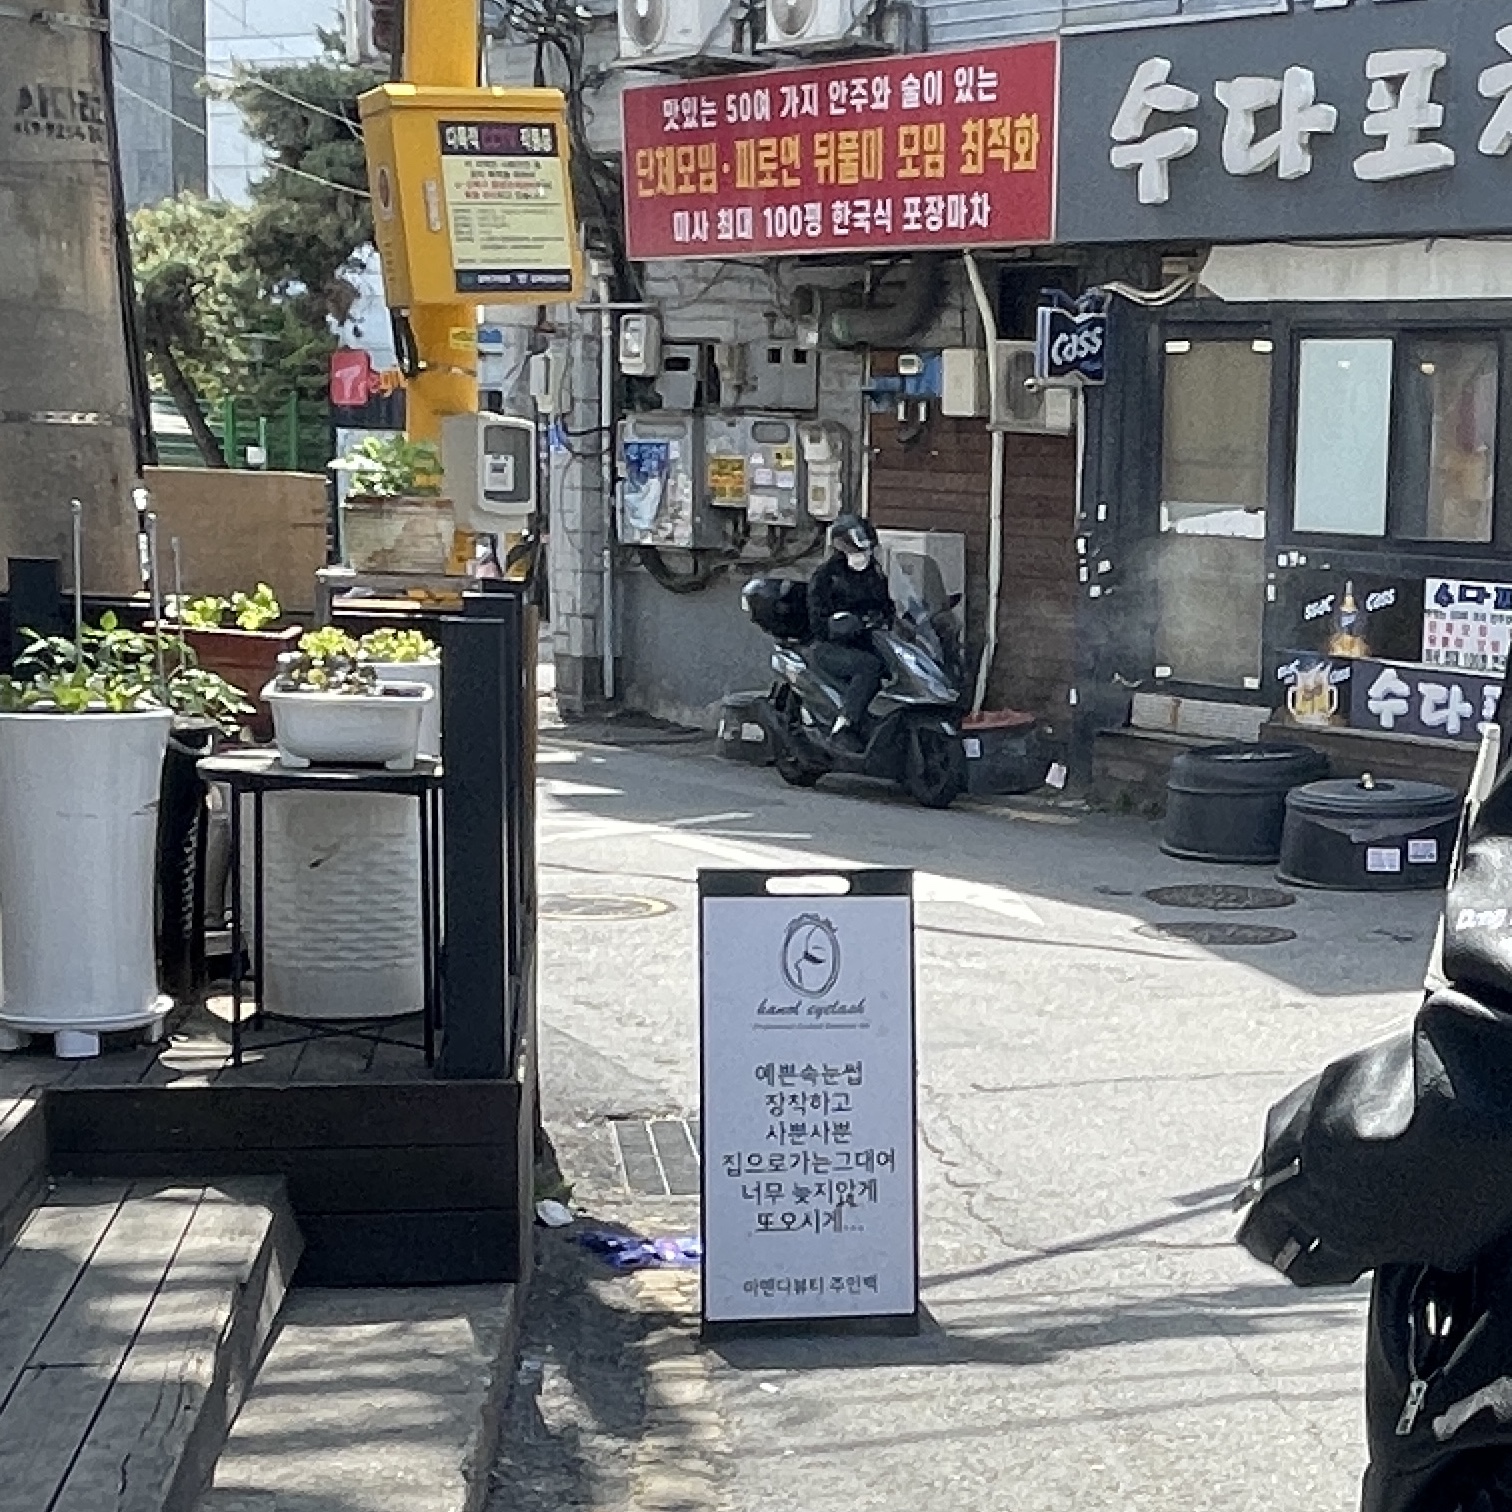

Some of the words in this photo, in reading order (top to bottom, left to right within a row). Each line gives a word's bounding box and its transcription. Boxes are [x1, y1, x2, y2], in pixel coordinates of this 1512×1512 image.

[663, 96, 717, 132] 맛있는
[725, 88, 771, 124] 50여
[779, 82, 819, 119] 가지
[828, 75, 892, 116] 안주와
[900, 69, 944, 110] 술이
[953, 65, 999, 104] 있는
[813, 126, 885, 185] 뒤풀이
[896, 122, 946, 180] 모임
[959, 112, 1041, 175] 최적화
[673, 210, 709, 243] 미사
[717, 206, 753, 240] 최대
[763, 202, 823, 238] 100평
[830, 197, 894, 236] 한국식
[902, 191, 991, 231] 포장마차
[1051, 326, 1103, 366] Cass
[765, 1090, 853, 1117] 장착하고
[765, 1120, 853, 1146] 사뿐사뿐
[722, 1147, 896, 1177] 집으로가는그대여
[741, 1180, 785, 1206] 너무
